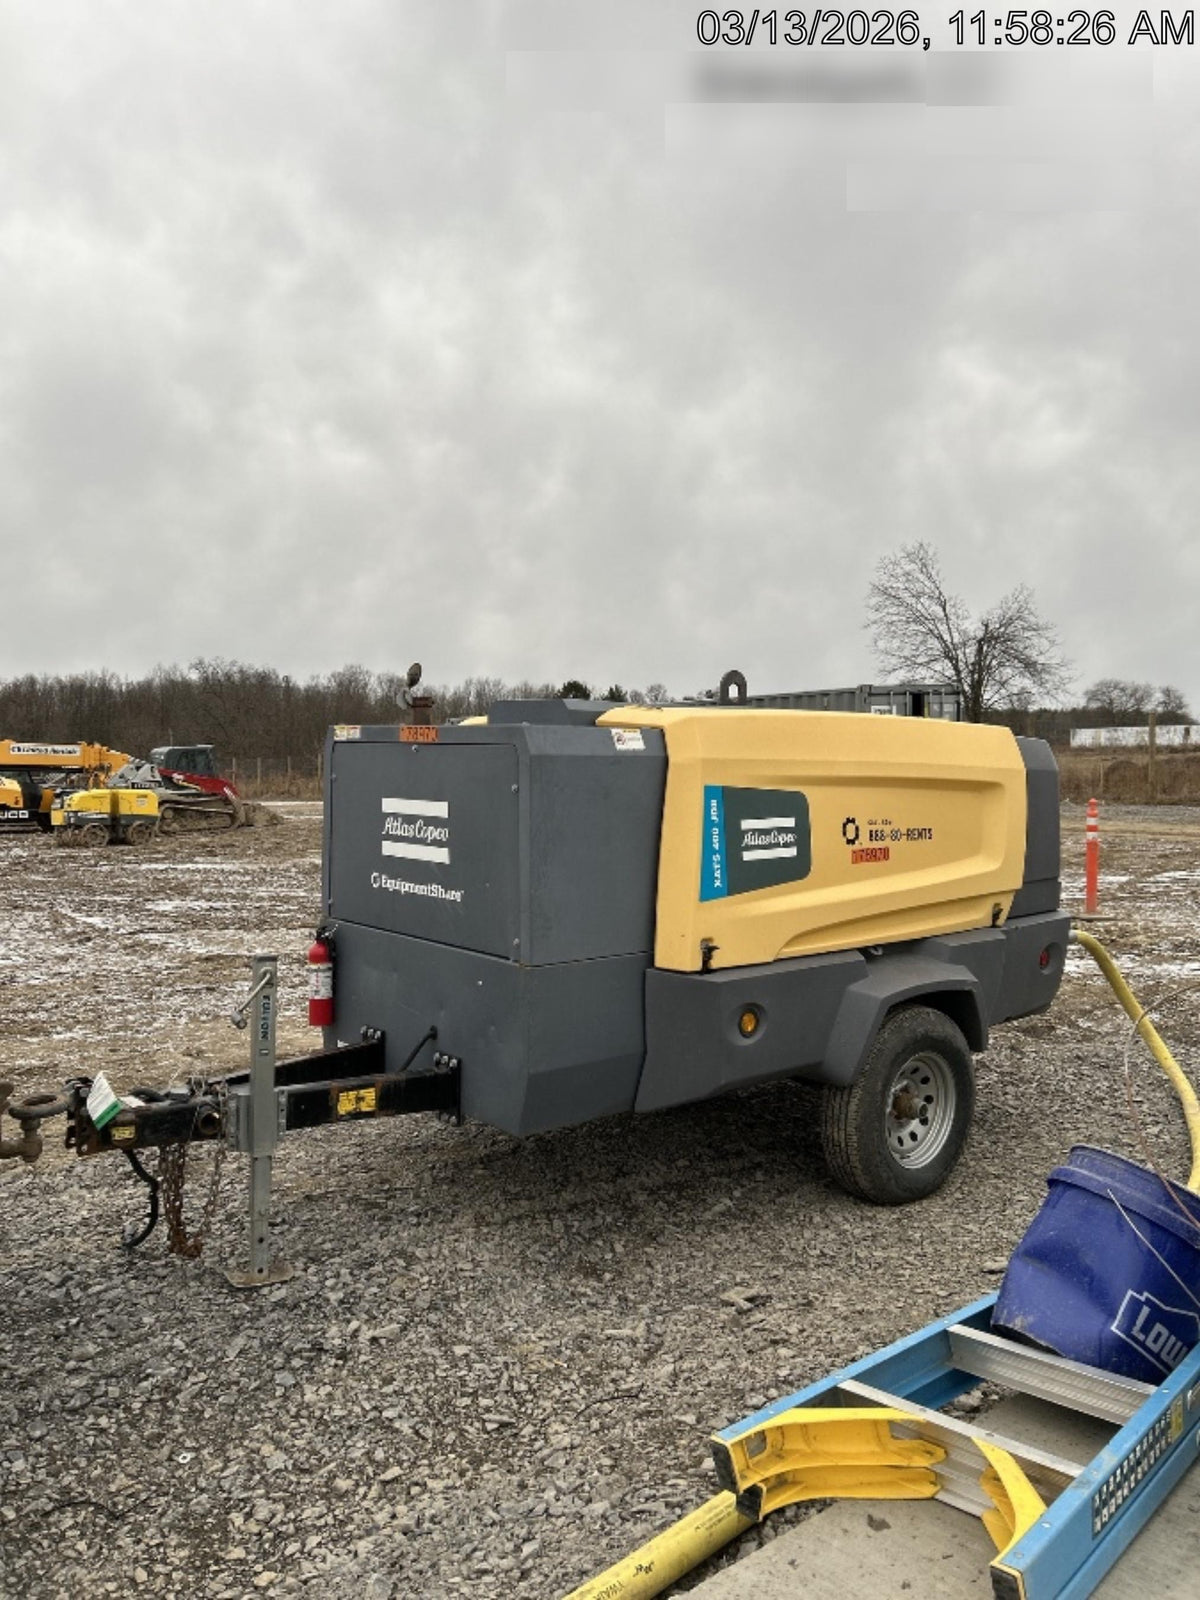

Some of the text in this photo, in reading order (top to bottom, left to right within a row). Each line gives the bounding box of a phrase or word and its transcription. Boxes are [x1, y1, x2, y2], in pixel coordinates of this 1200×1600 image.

[382, 816, 449, 843] Atlas Copco
[741, 831, 770, 847] Atlas
[1130, 1304, 1189, 1370] LOW
